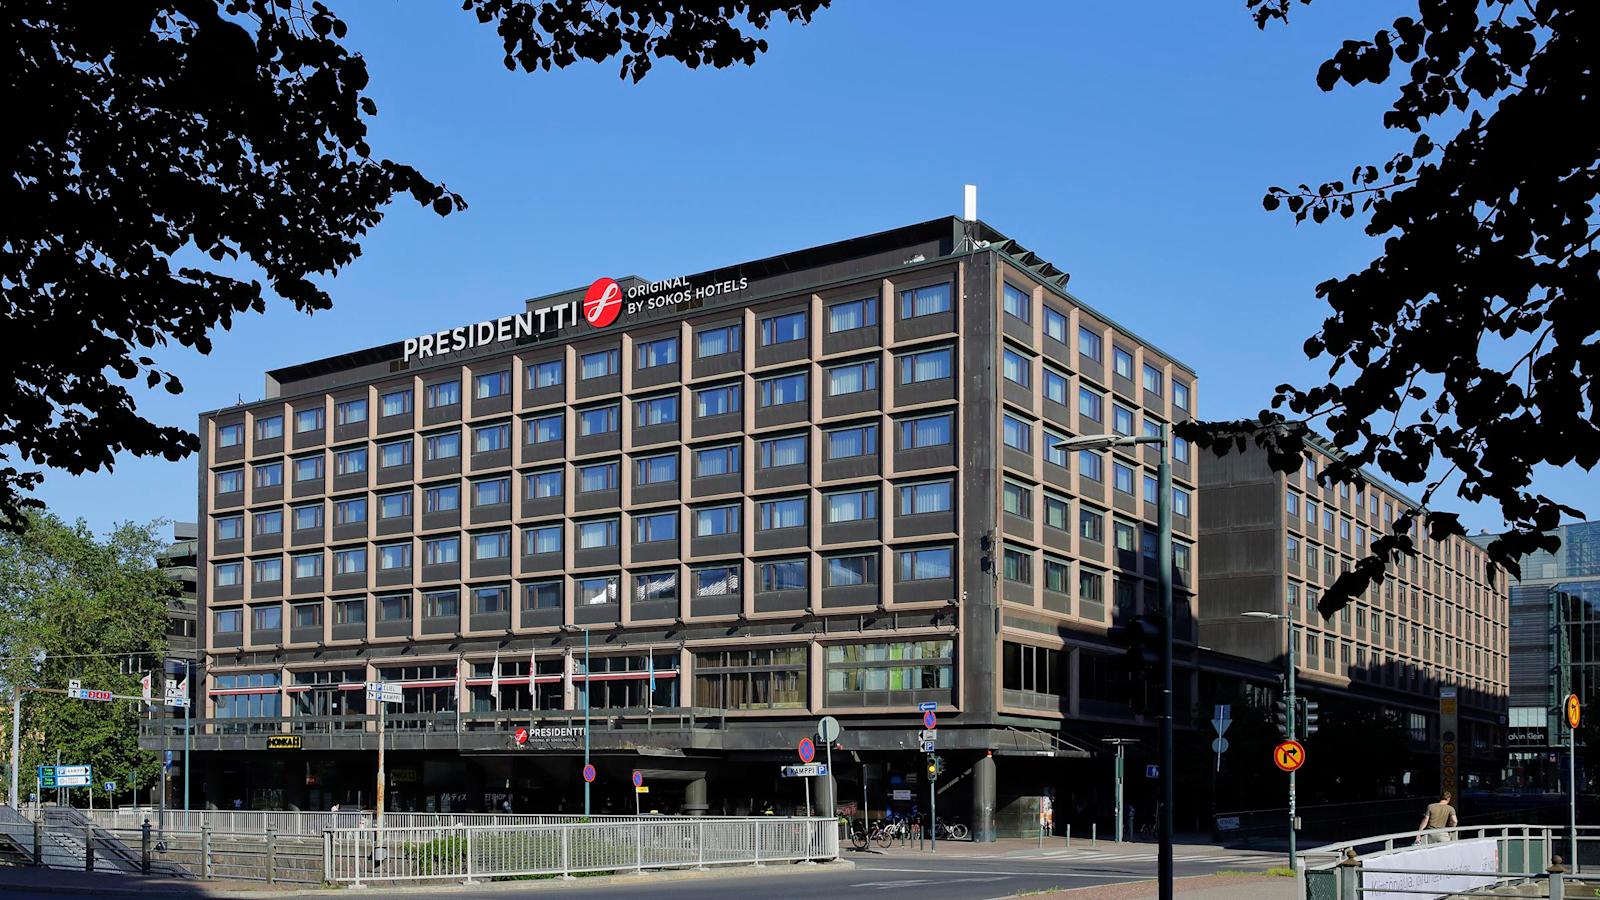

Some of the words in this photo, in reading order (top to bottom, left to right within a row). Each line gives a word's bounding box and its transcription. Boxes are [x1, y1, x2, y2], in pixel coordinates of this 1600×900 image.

[627, 275, 691, 299] ORIGINAL
[627, 299, 644, 315] BY
[647, 290, 692, 310] SOKOS
[695, 277, 748, 300] HOTELS
[403, 301, 578, 363] PRESIDENTTI
[529, 727, 587, 737] PRESIDENTTI
[1508, 732, 1526, 741] alvin
[1527, 732, 1545, 741] Klein
[791, 766, 815, 775] KAMPPI
